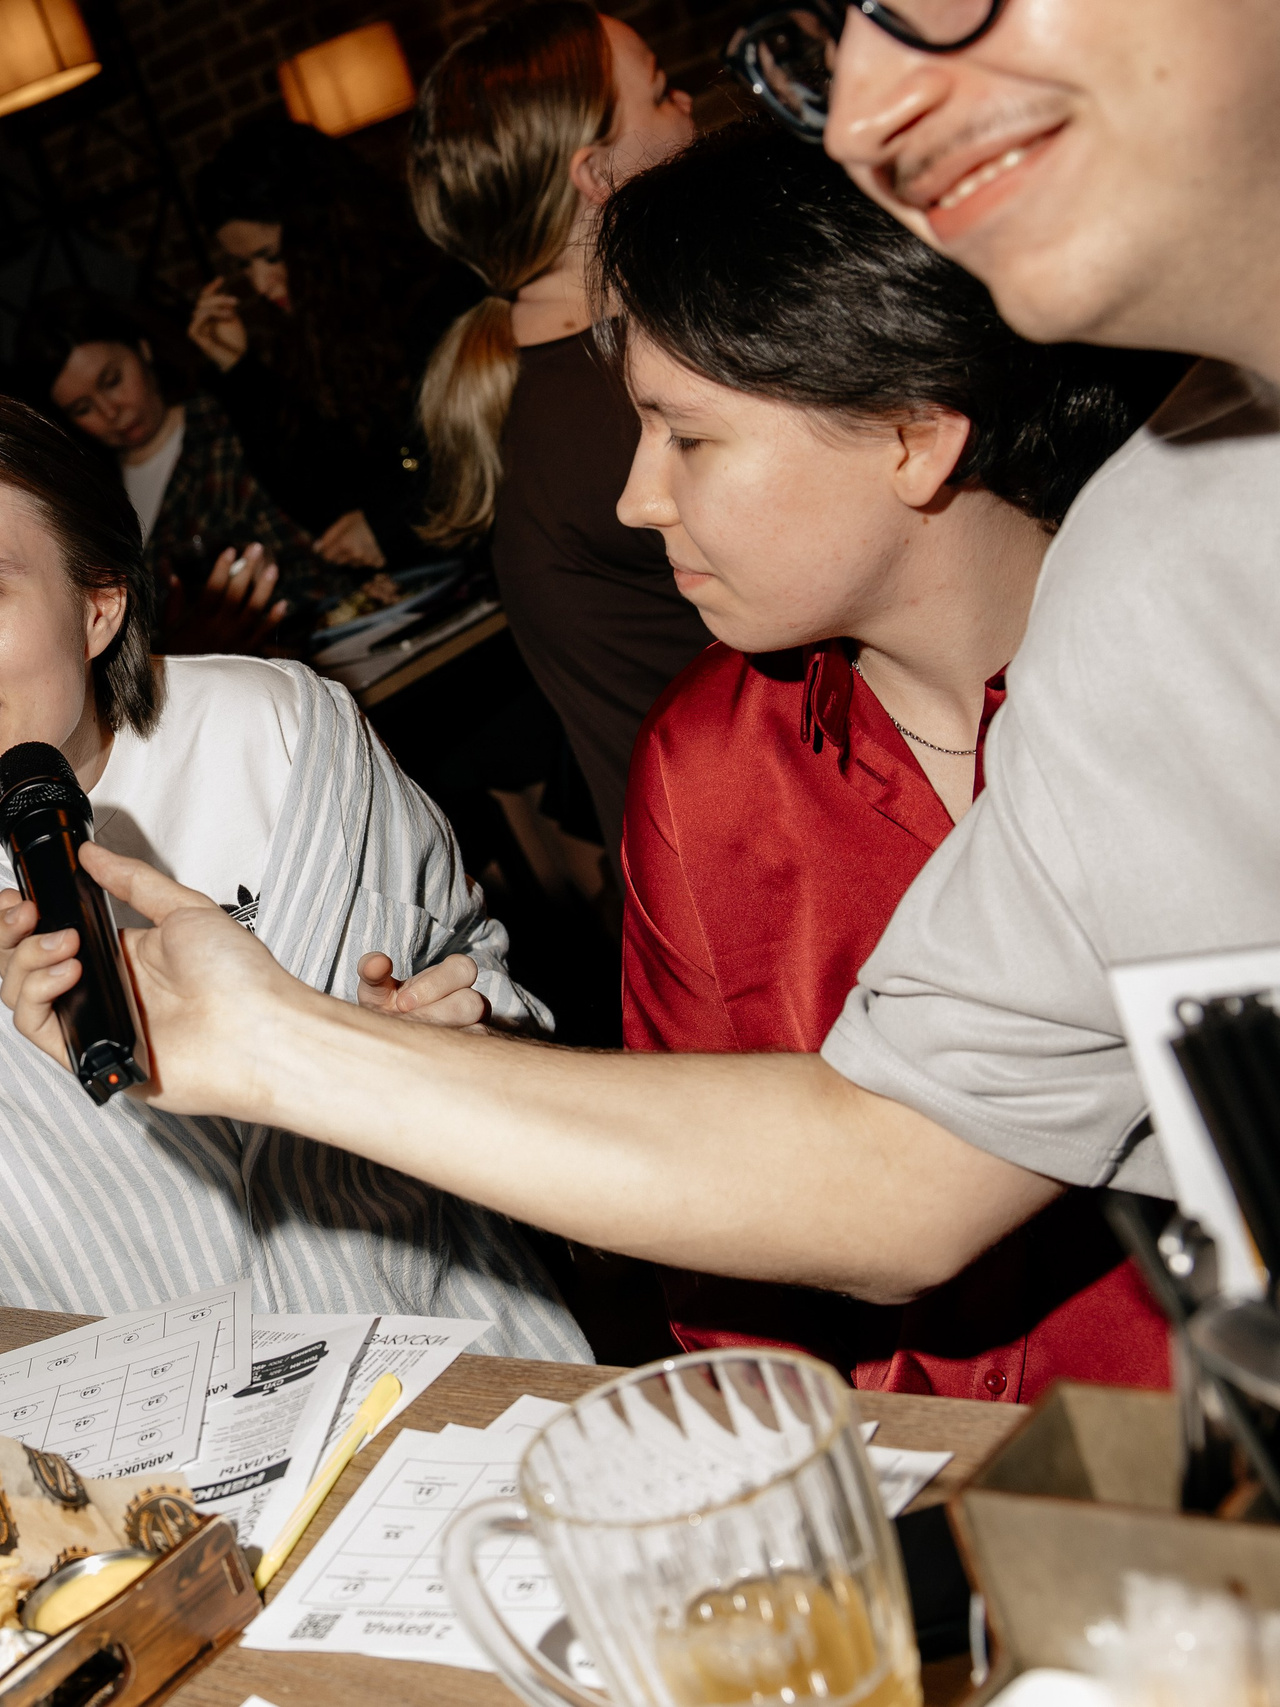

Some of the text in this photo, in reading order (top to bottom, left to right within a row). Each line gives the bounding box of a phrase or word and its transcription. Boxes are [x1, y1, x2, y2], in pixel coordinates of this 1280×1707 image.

[191, 1310, 205, 1319] 14
[54, 1357, 69, 1366] 30
[262, 1378, 283, 1390] СУП
[82, 1387, 97, 1396] 44
[139, 1431, 155, 1441] 40
[115, 1451, 173, 1478] KARAOKE
[219, 1448, 286, 1477] САЛАТЫ
